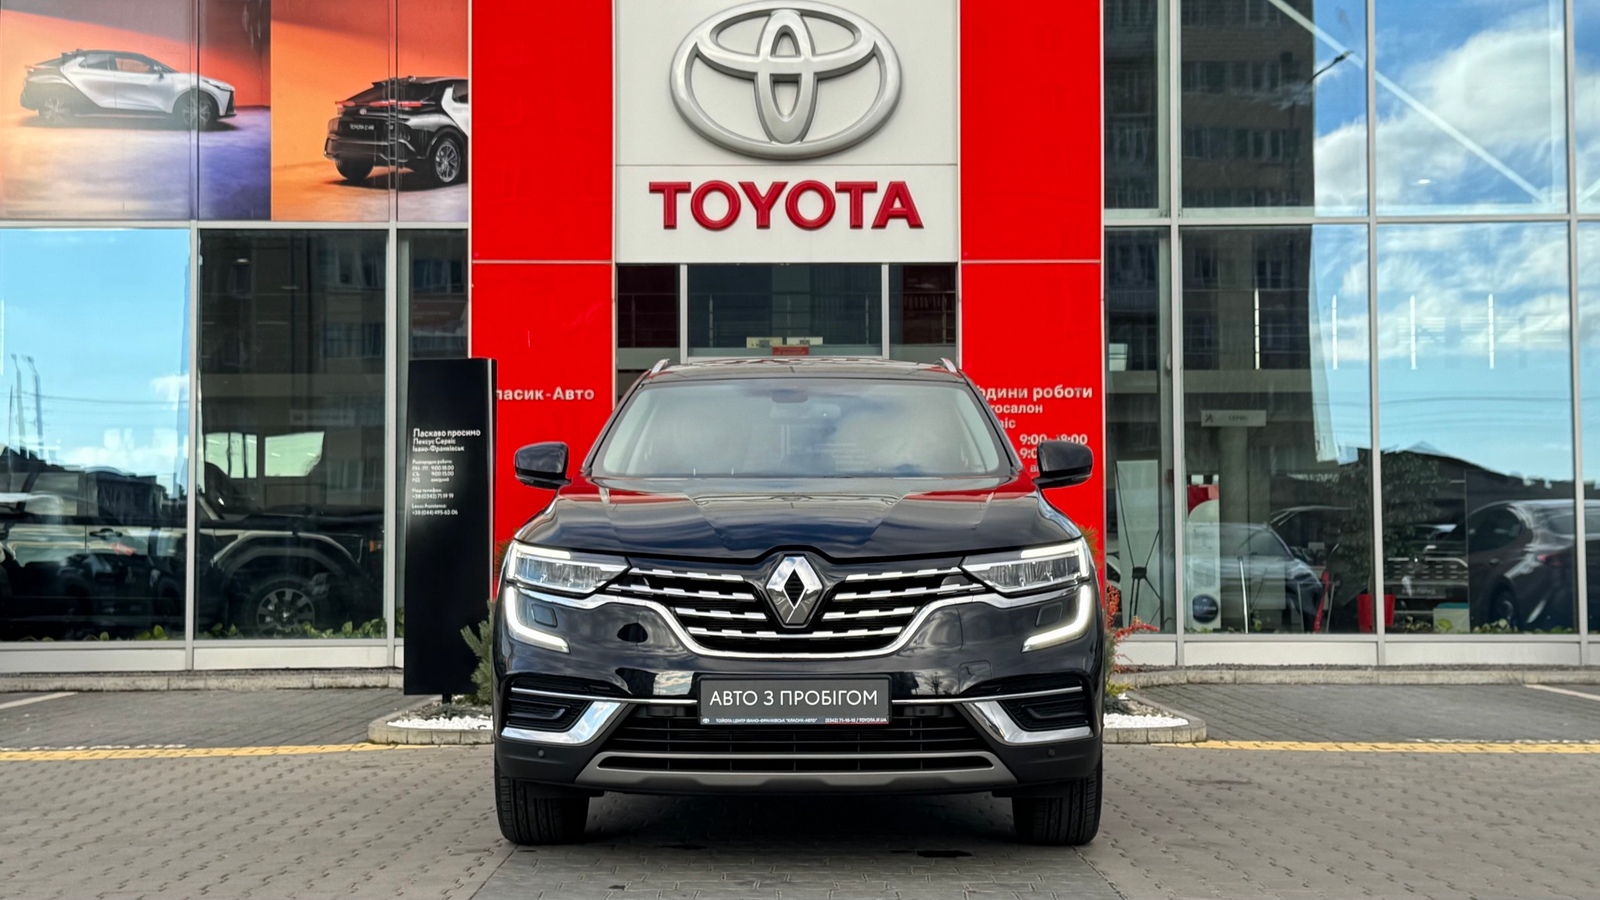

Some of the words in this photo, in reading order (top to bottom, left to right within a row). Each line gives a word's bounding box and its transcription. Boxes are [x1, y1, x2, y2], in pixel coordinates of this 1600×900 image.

[649, 179, 924, 231] TOYOTA
[496, 386, 595, 401] ласик-Авто
[977, 385, 1028, 401] одини
[1033, 384, 1092, 402] роботи
[447, 429, 481, 439] просимо
[709, 690, 758, 706] АВТО
[780, 690, 877, 706] ПРОБІГОМ
